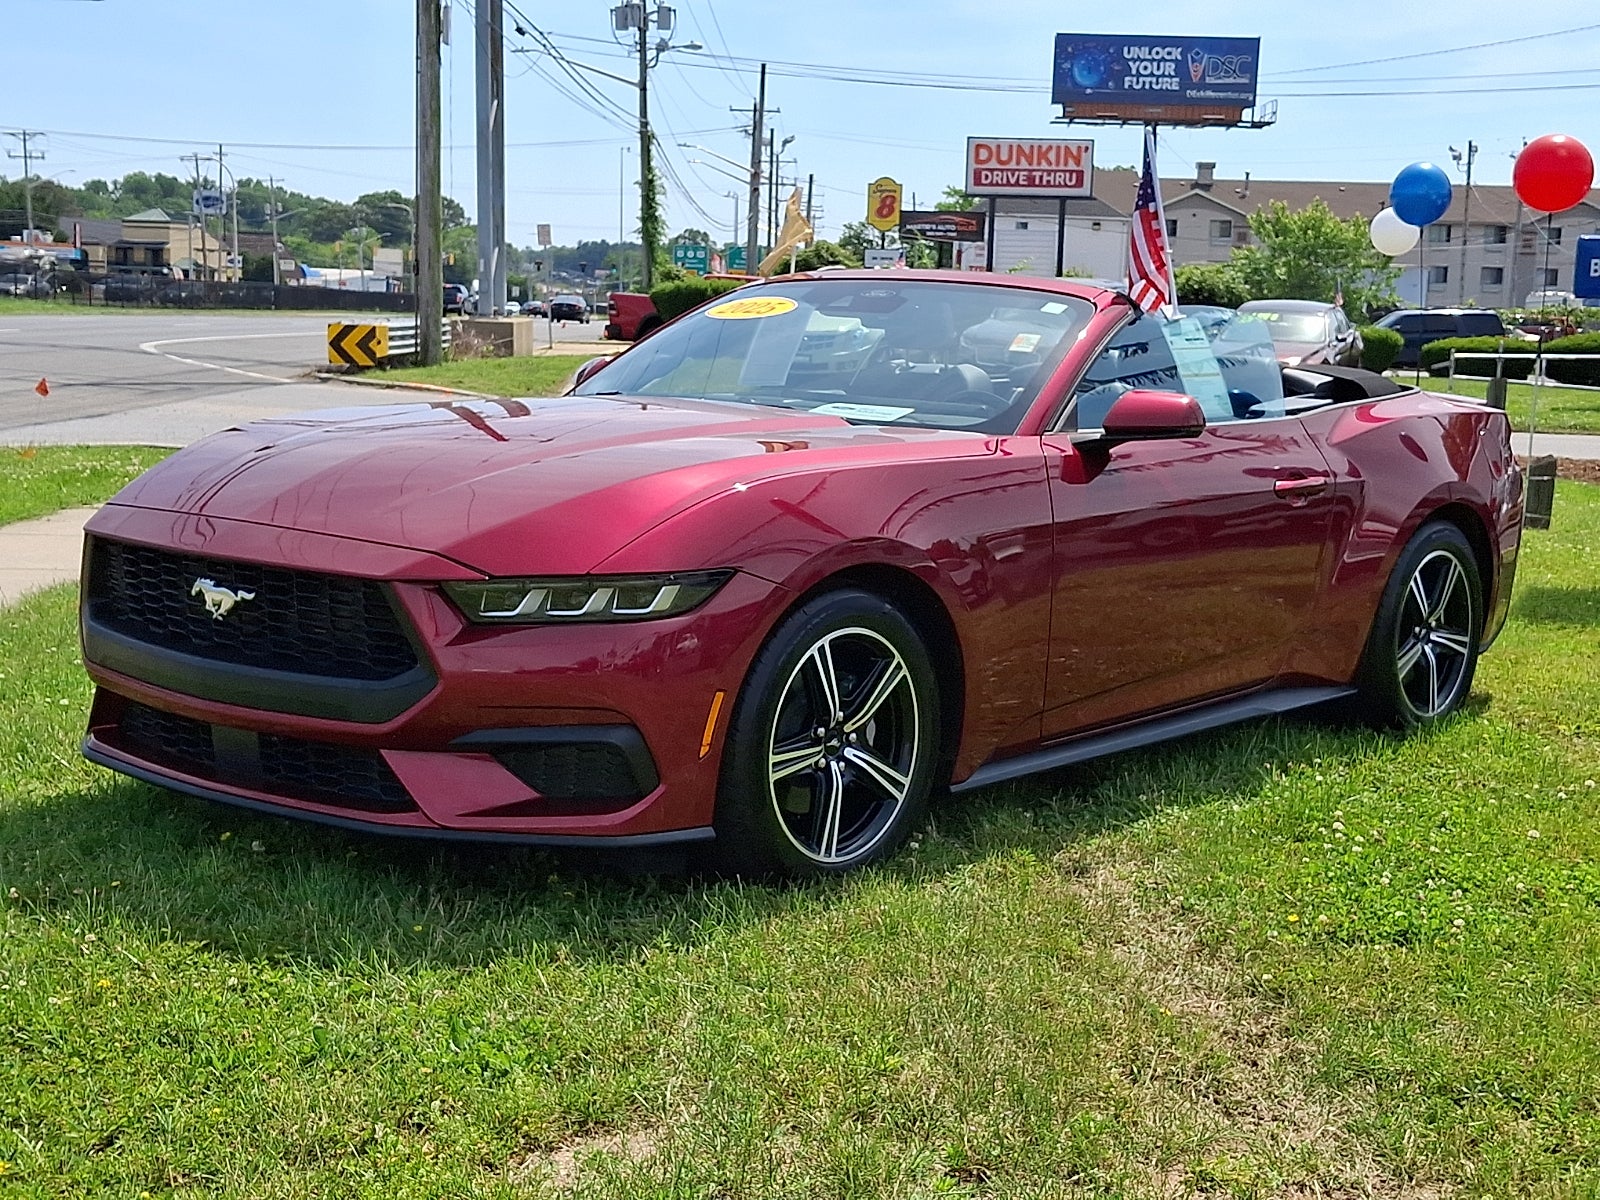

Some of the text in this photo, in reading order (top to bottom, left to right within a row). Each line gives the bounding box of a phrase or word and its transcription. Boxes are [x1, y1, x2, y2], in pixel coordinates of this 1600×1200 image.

[1123, 46, 1182, 60] UNLOCK
[1127, 61, 1176, 76] YOUR
[1205, 55, 1252, 79] DSC
[1124, 76, 1180, 90] FUTURE
[974, 143, 1089, 168] DUNKIN'
[981, 171, 1077, 186] DRIVE THRU
[875, 194, 896, 219] 8
[715, 301, 789, 315] 2025
